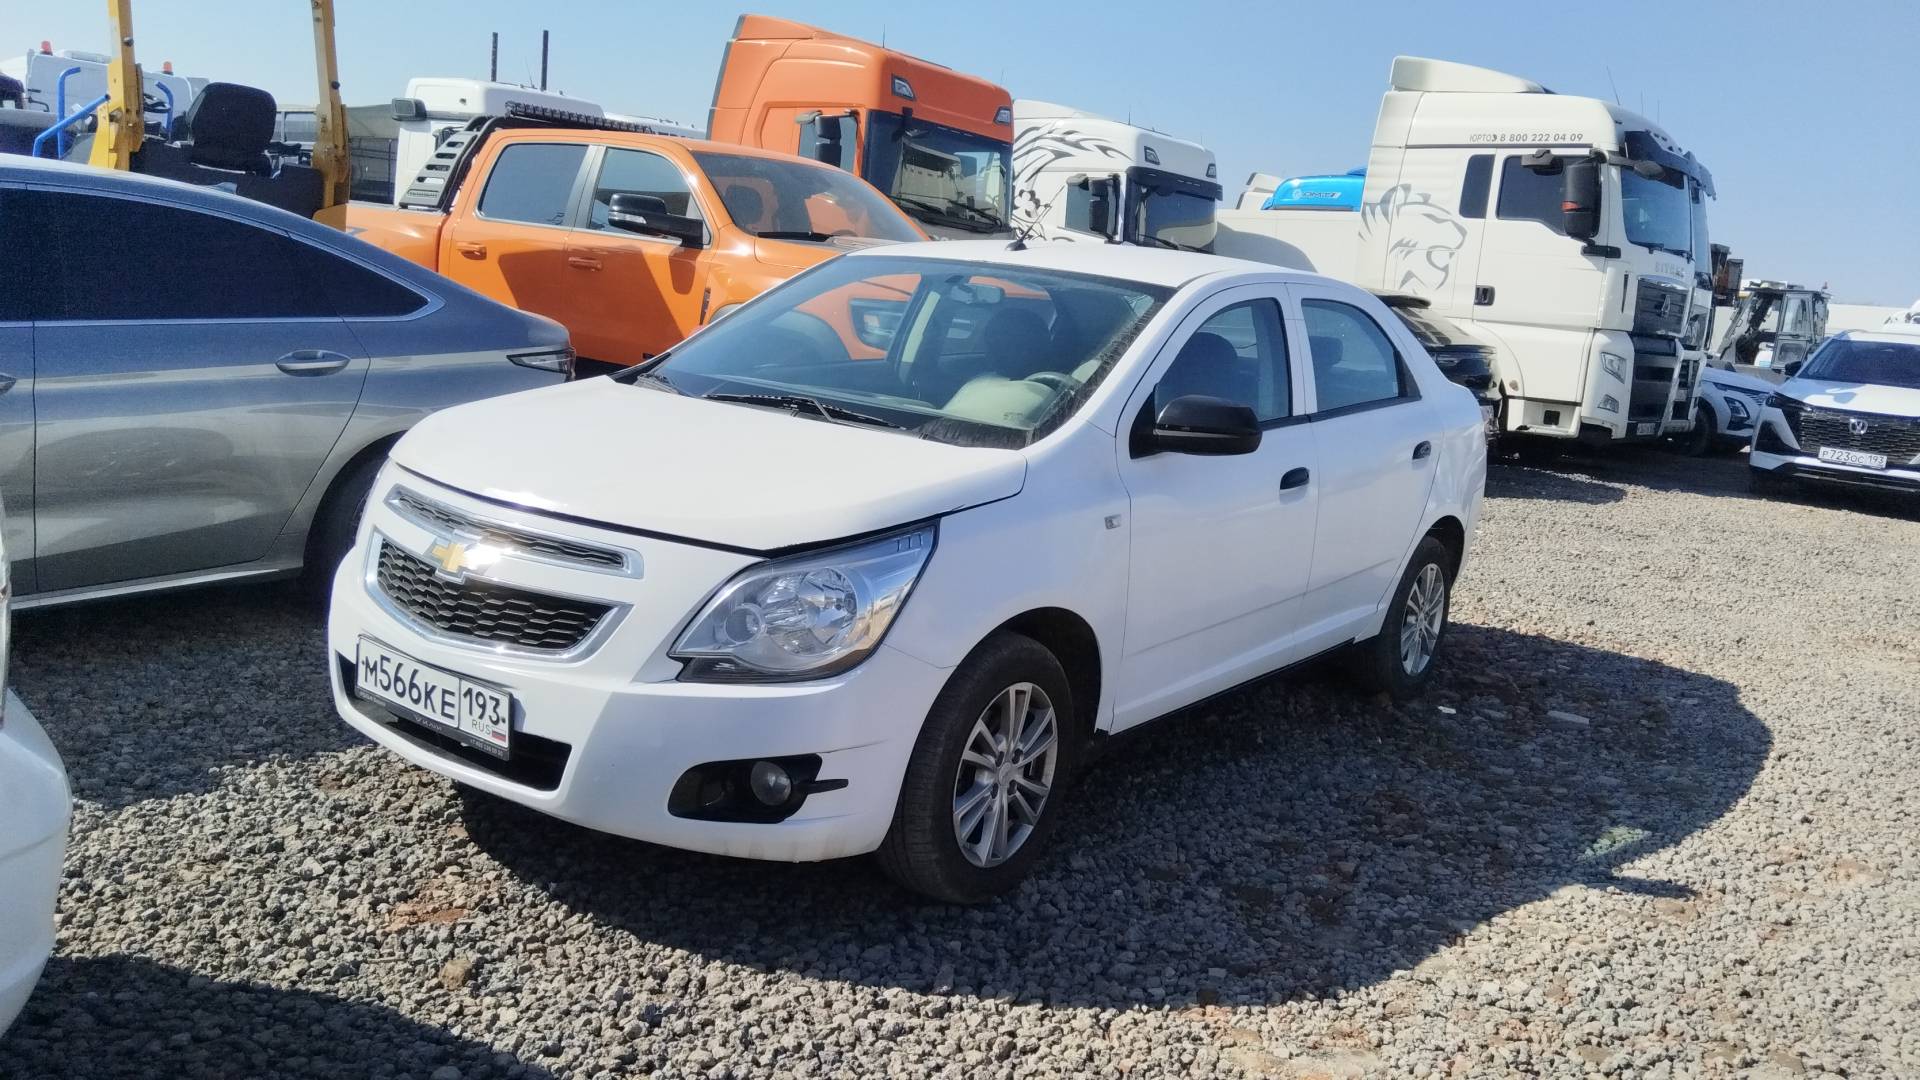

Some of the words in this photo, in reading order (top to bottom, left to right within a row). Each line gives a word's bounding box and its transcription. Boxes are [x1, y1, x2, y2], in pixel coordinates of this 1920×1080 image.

[1500, 133, 1506, 142] 8
[1509, 133, 1528, 142] 800
[1531, 133, 1550, 142] 222
[1553, 133, 1567, 142] 04
[1570, 133, 1584, 142] 09
[462, 687, 500, 726] 193
[471, 719, 491, 736] RUS
